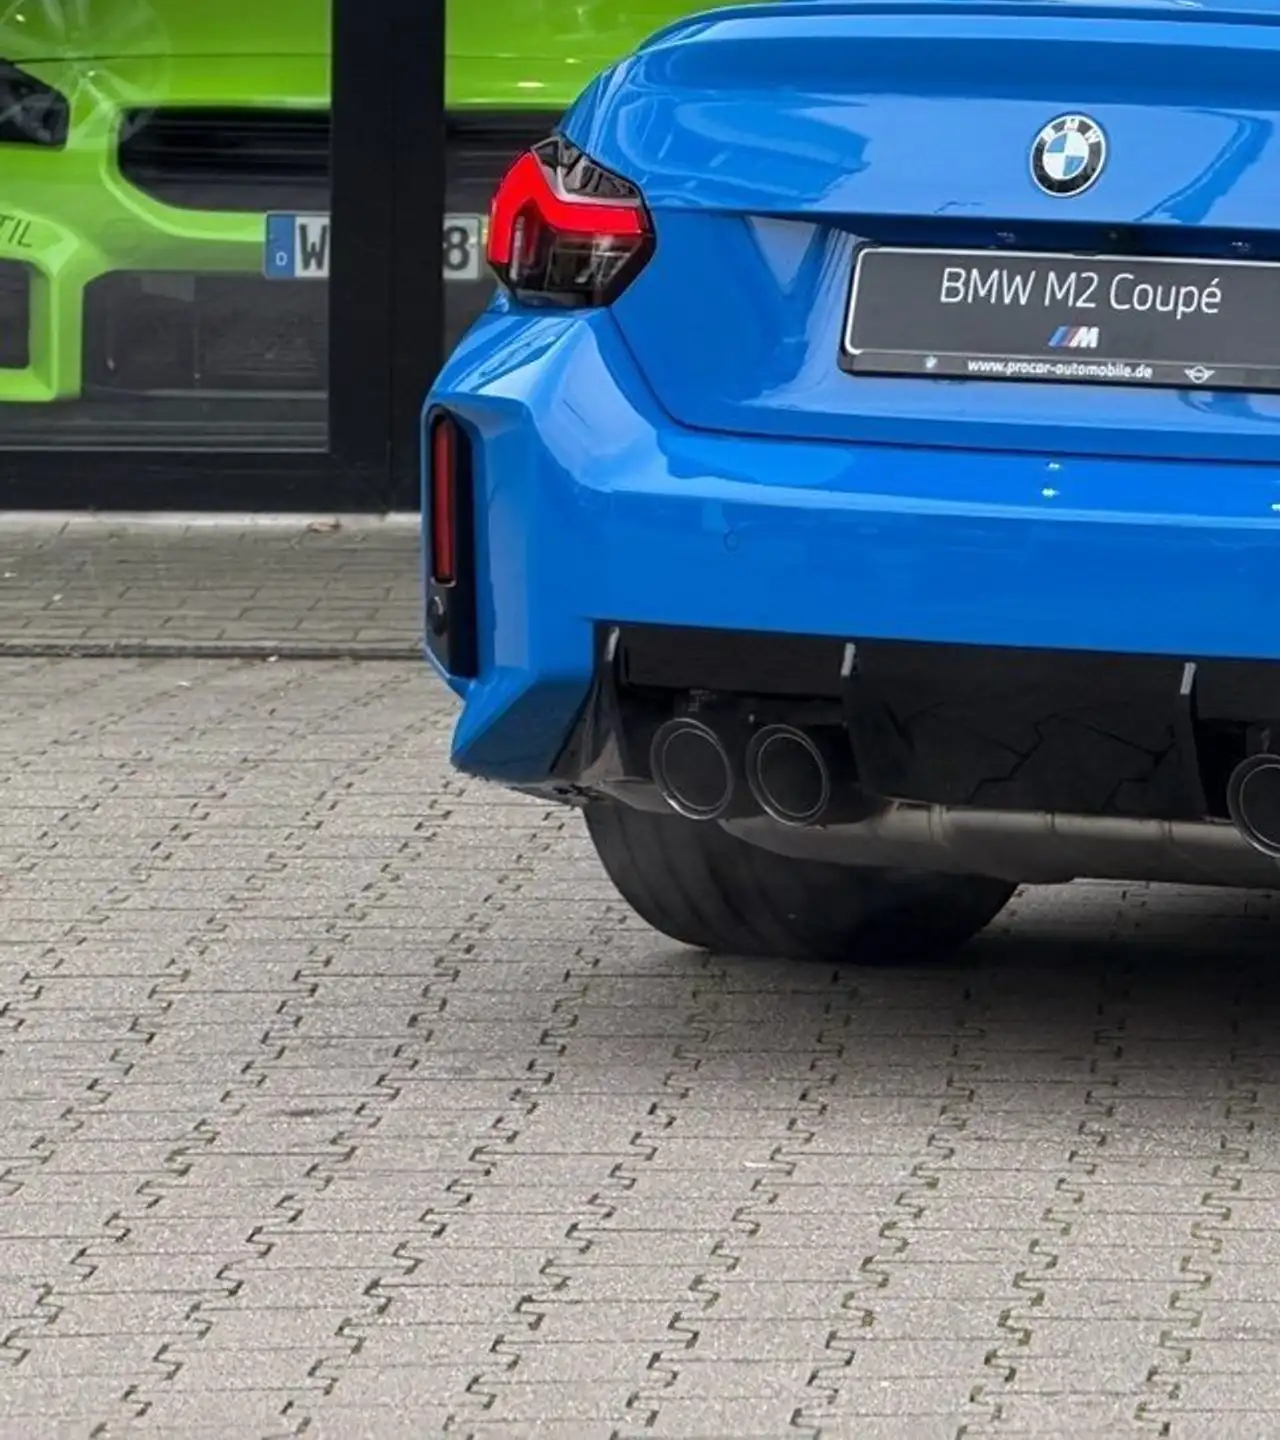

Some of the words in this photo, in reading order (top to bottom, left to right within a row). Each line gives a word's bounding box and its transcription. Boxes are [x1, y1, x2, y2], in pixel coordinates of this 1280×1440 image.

[939, 267, 1037, 306] BMW
[1043, 270, 1100, 308] M2
[1109, 272, 1223, 320] Coupé
[967, 359, 1153, 379] www.procar-automobile.de
